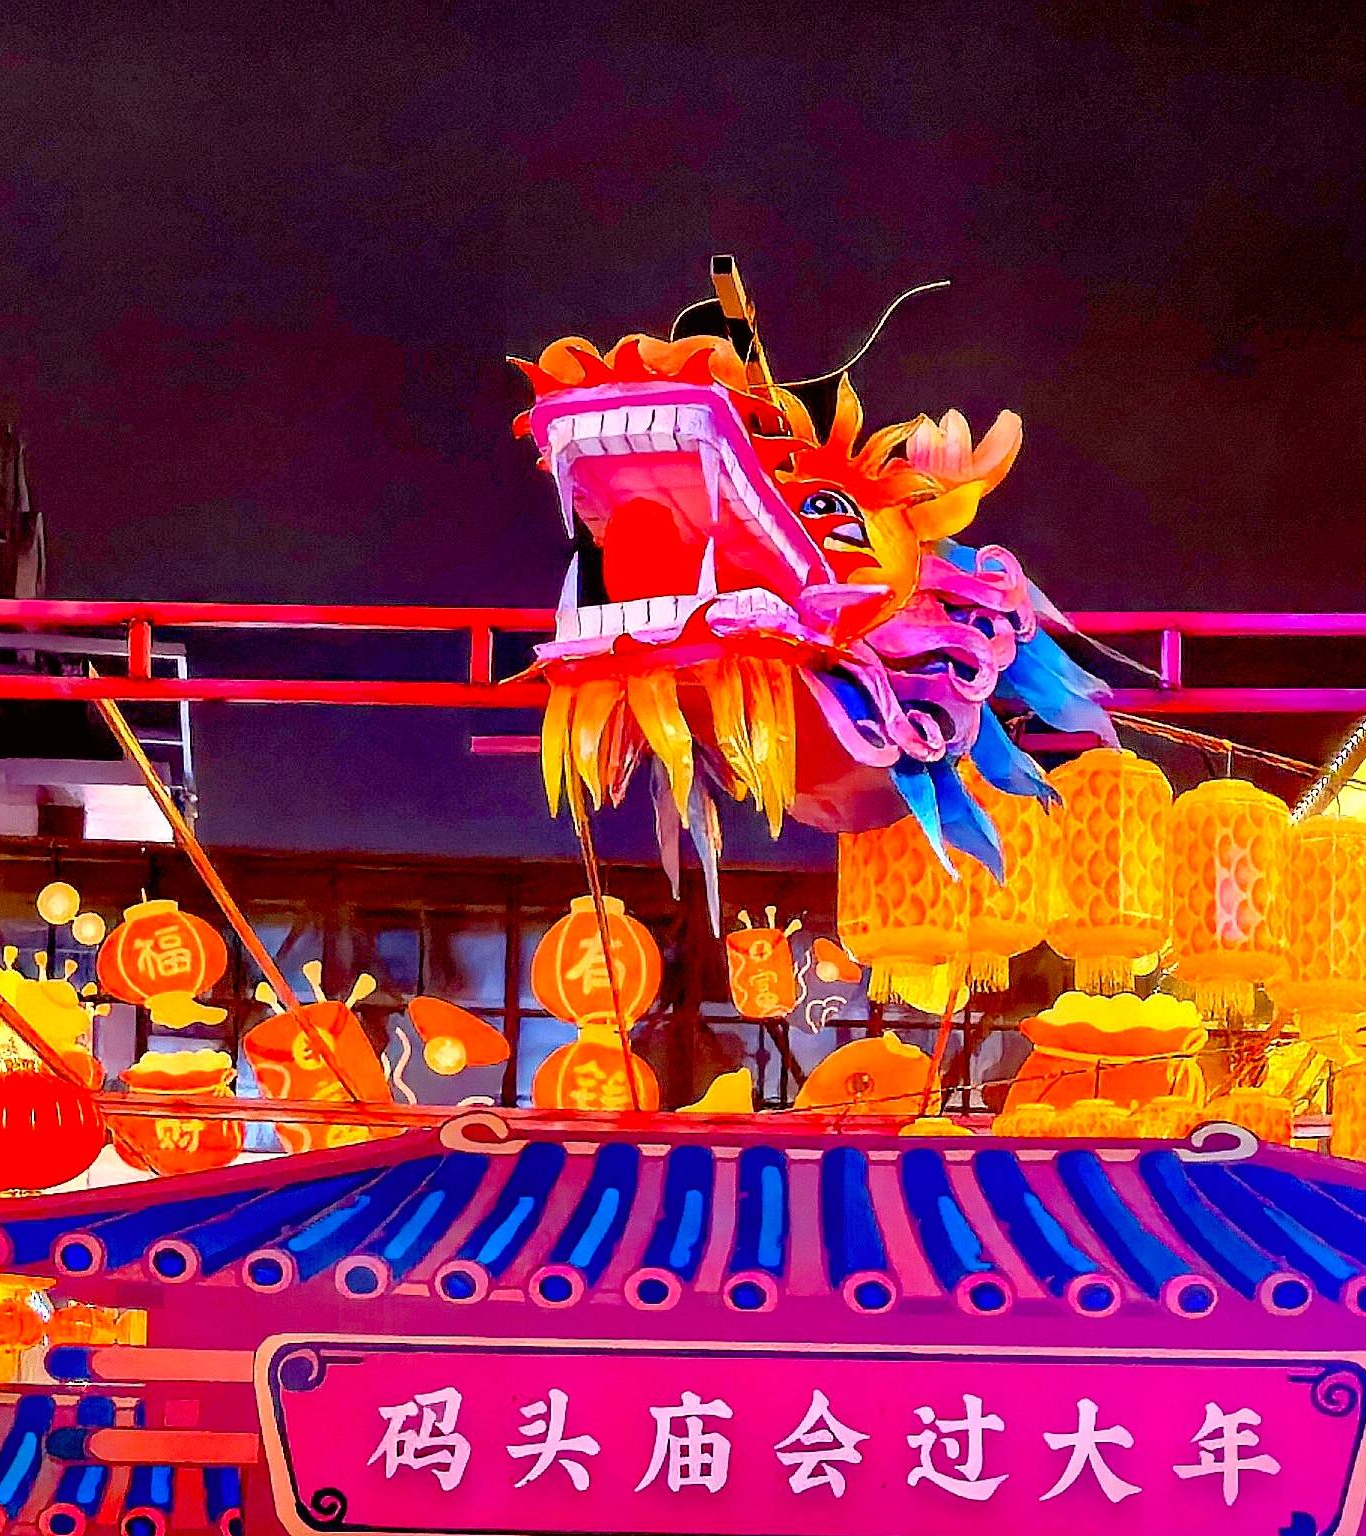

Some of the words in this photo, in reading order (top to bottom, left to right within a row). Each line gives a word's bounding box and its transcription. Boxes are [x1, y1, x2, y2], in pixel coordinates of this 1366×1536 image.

[133, 924, 192, 980] 福
[367, 1384, 1283, 1507] 码头庙会过大年
